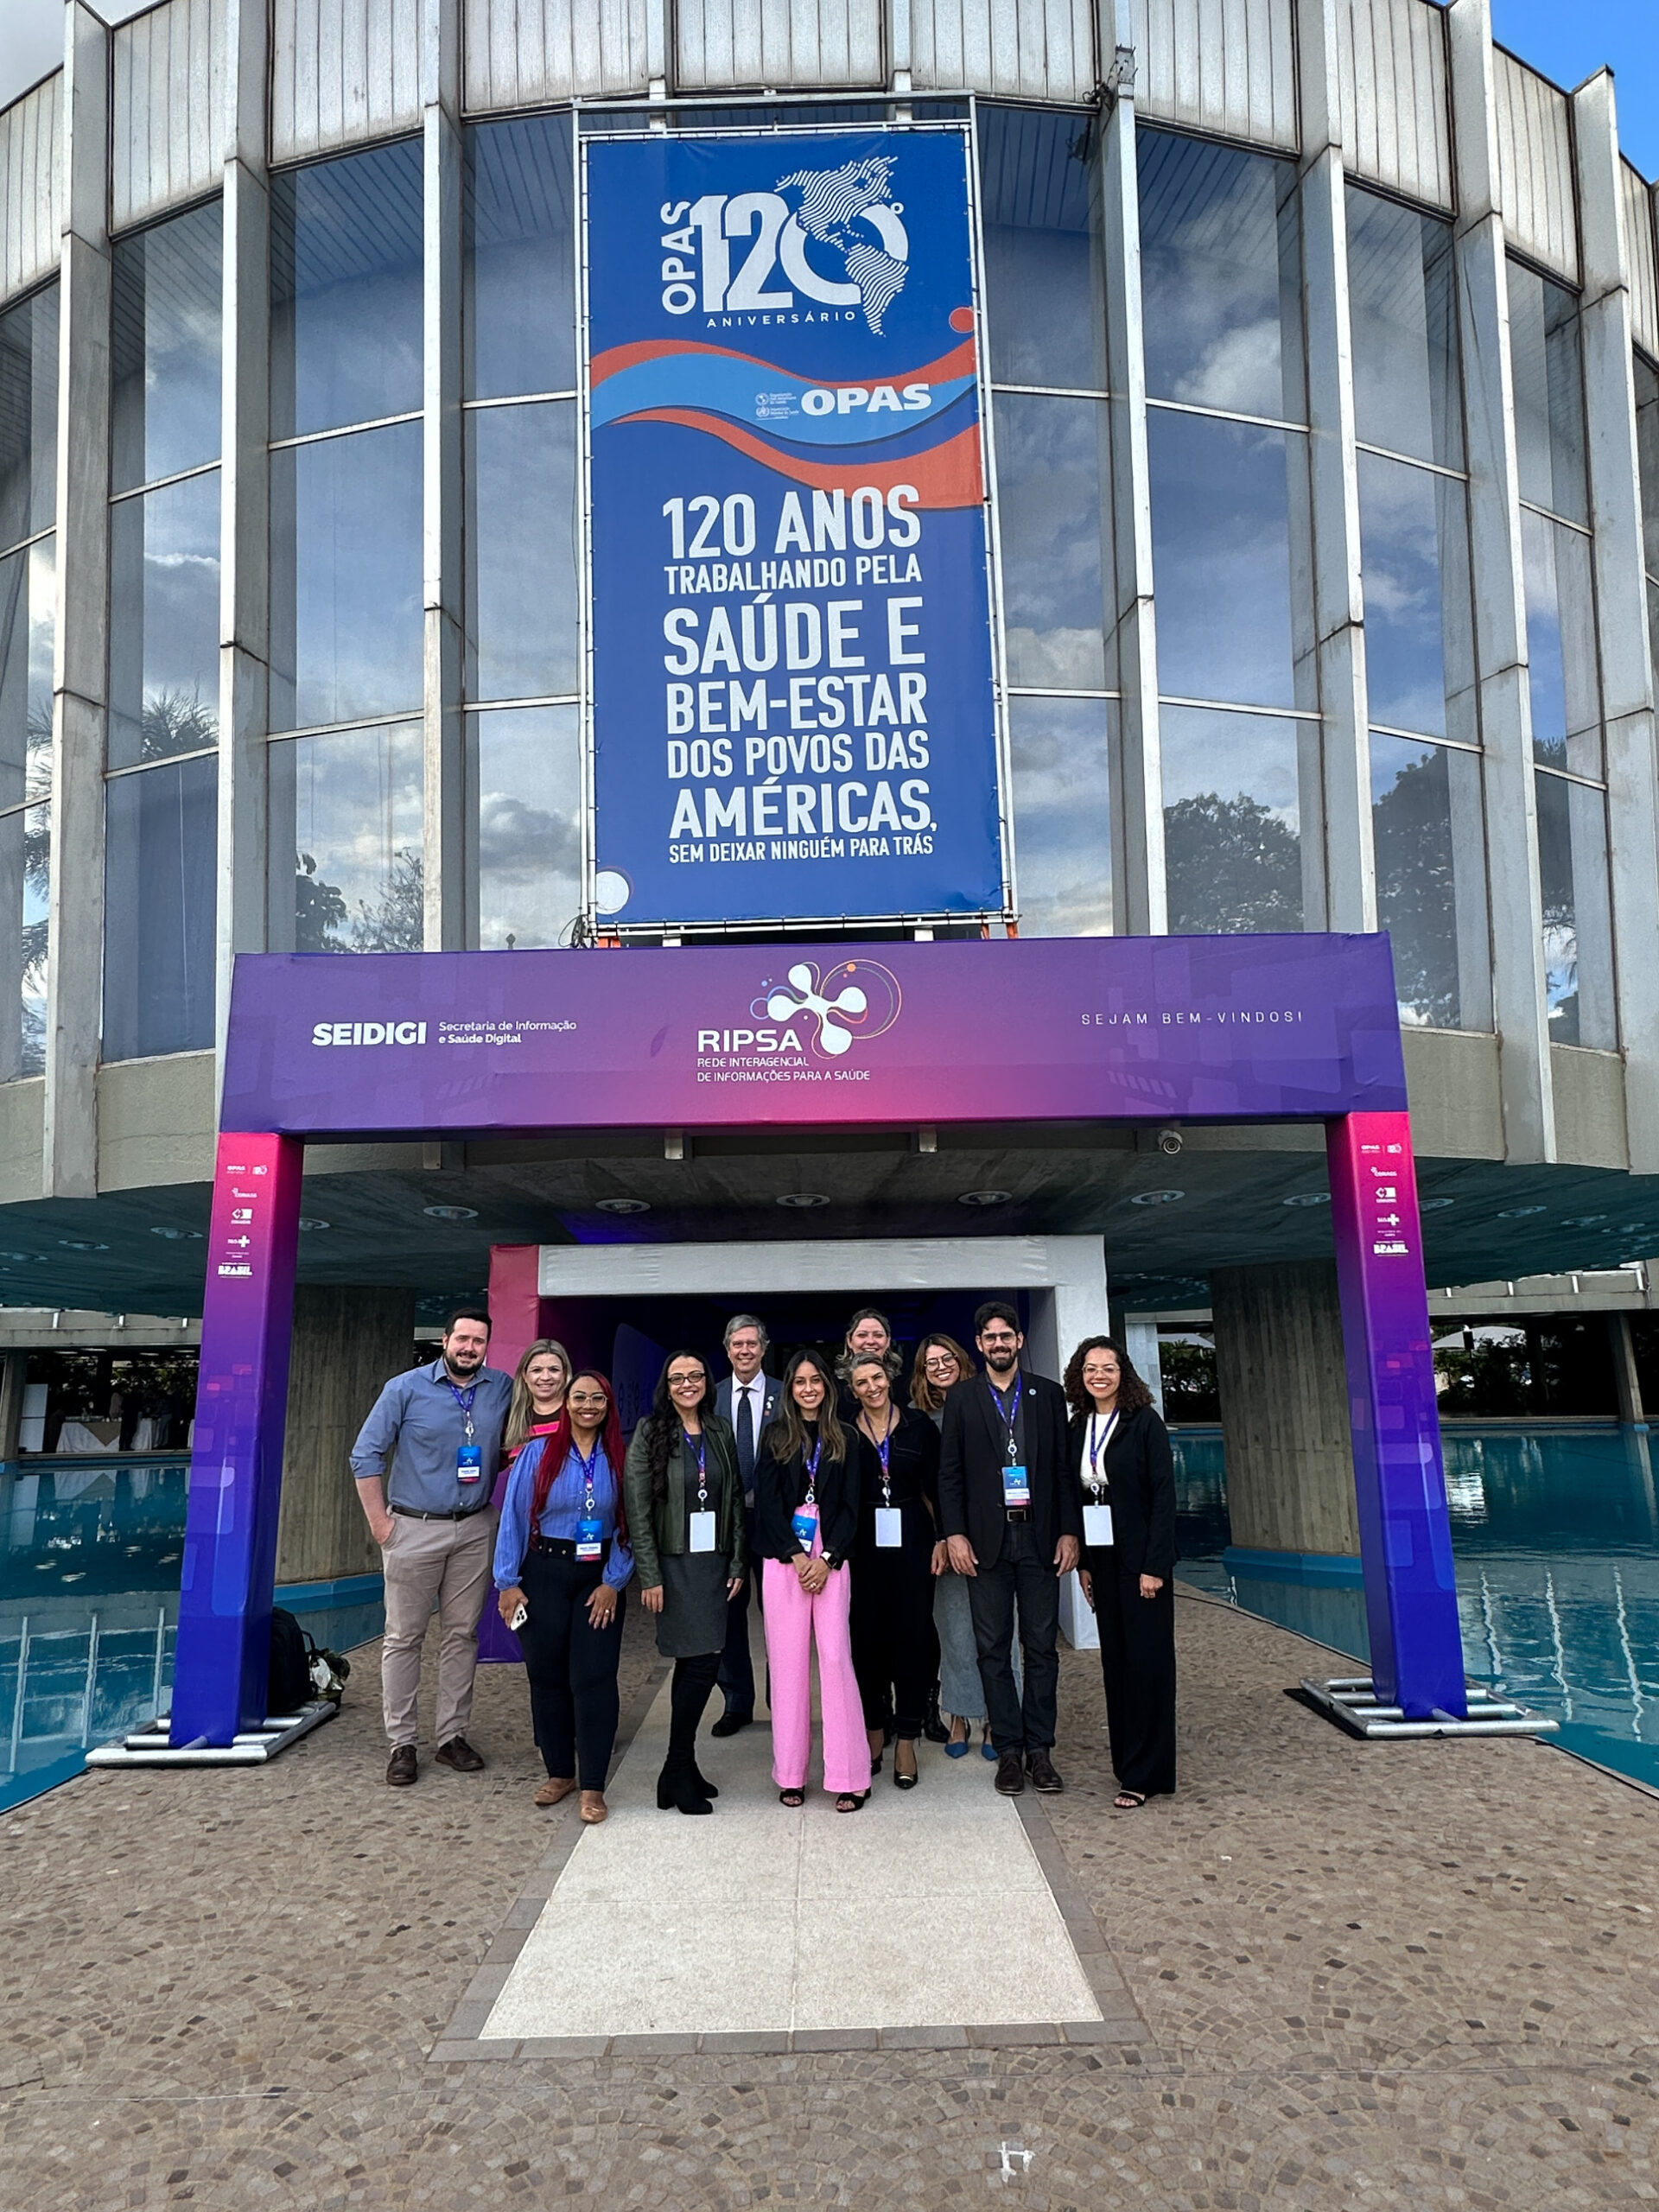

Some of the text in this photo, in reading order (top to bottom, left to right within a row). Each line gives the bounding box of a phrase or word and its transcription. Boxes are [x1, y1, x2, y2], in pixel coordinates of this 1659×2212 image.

[660, 200, 696, 315] OPAS
[707, 310, 855, 328] ANIVERSÁRIO
[801, 383, 932, 416] OPAS
[662, 484, 922, 560] 120 ANOS
[664, 553, 923, 595] TRABALHANDO PELA
[663, 593, 926, 676] SAÚDE E
[666, 672, 928, 735] BEM-ESTAR
[667, 729, 931, 779] DOS POVOS DAS
[669, 777, 938, 839] AMÉRICAS,
[669, 833, 934, 864] SEM DEIXAR NINGUÉM PARA TRÁS
[311, 1021, 427, 1046] SEIDIGI
[438, 1019, 578, 1033] Secretaria de Informação
[1081, 1011, 1303, 1026] SEJAM BEM-VINDOS!
[438, 1033, 522, 1046] e Saúde Digital
[697, 1029, 804, 1052] RIPSA
[697, 1057, 810, 1068] REDE INTERAGENCIAL
[697, 1068, 871, 1084] DE INFORMAÇÕES PARA A SAÚDE
